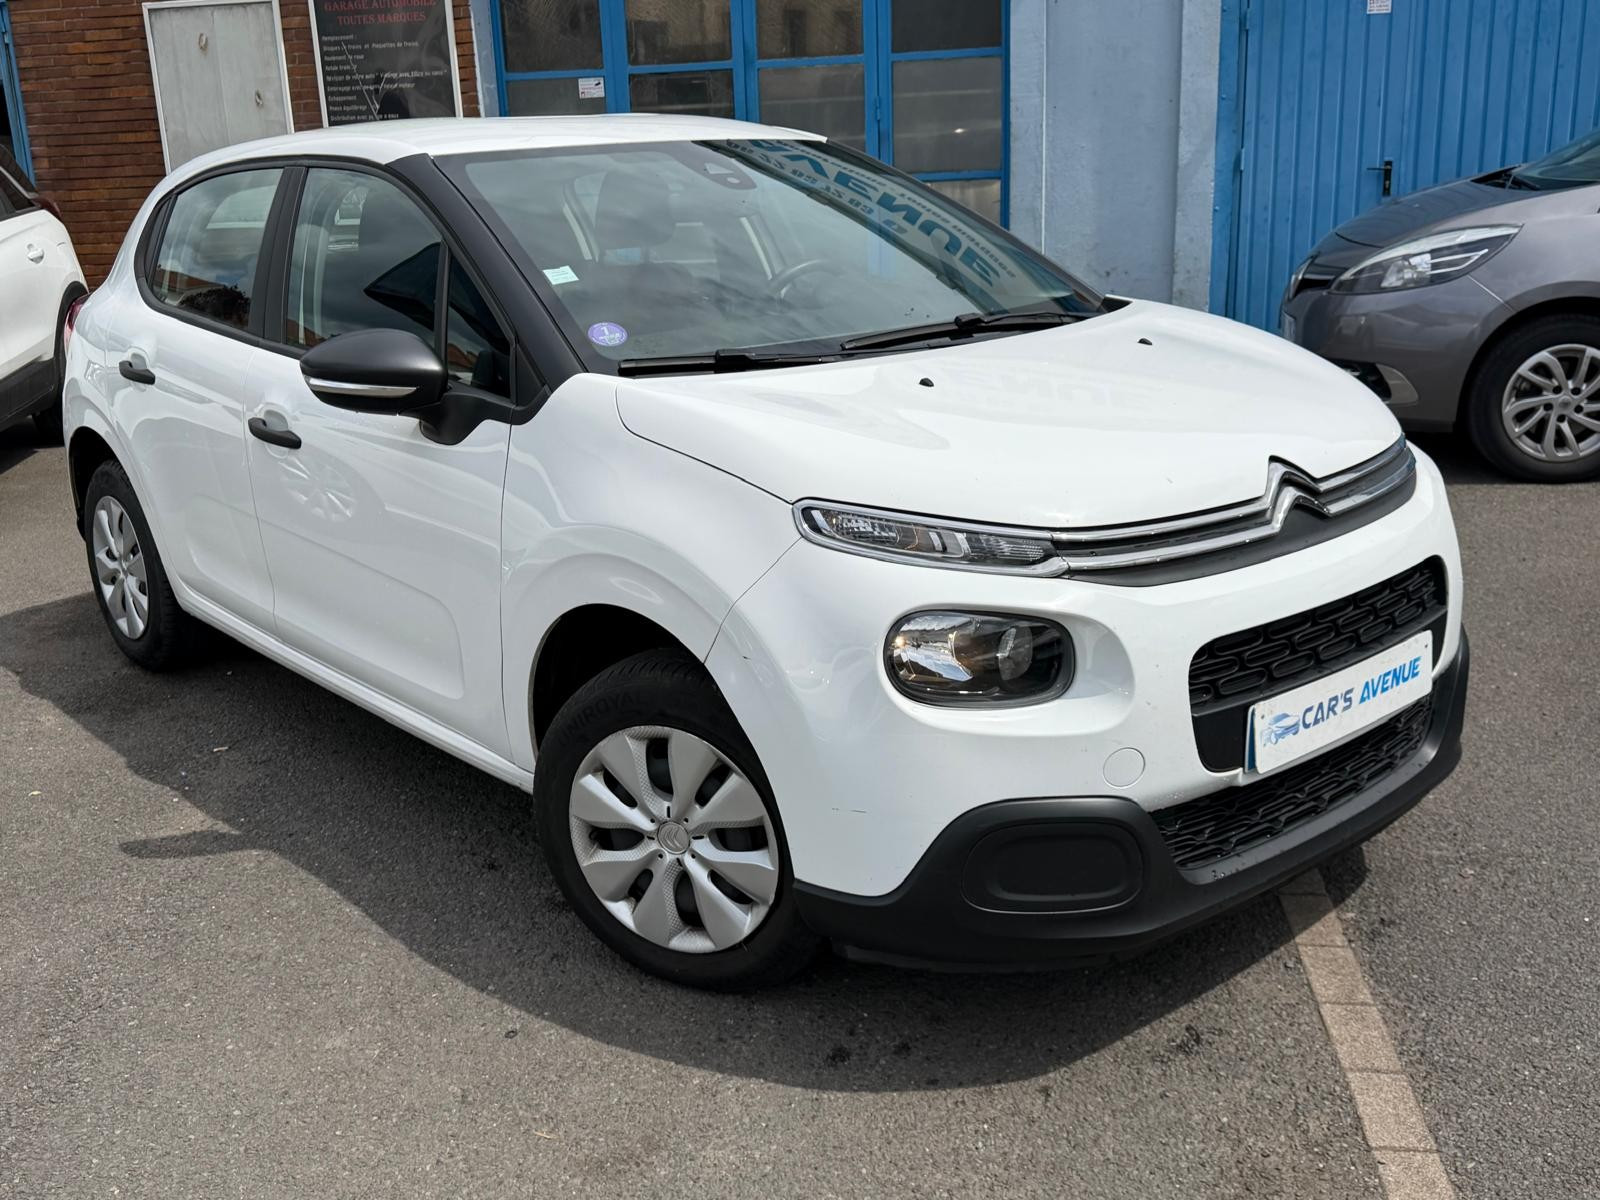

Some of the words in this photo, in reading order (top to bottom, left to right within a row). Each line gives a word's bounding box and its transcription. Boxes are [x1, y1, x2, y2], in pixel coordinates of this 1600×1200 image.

[324, 0, 369, 12] GARAGE
[371, 0, 437, 9] AUTOMOBILE
[337, 15, 376, 26] TOUTES
[377, 11, 426, 23] MARQUES
[1302, 688, 1354, 730] CAR'S
[1359, 656, 1421, 705] AVENUE
